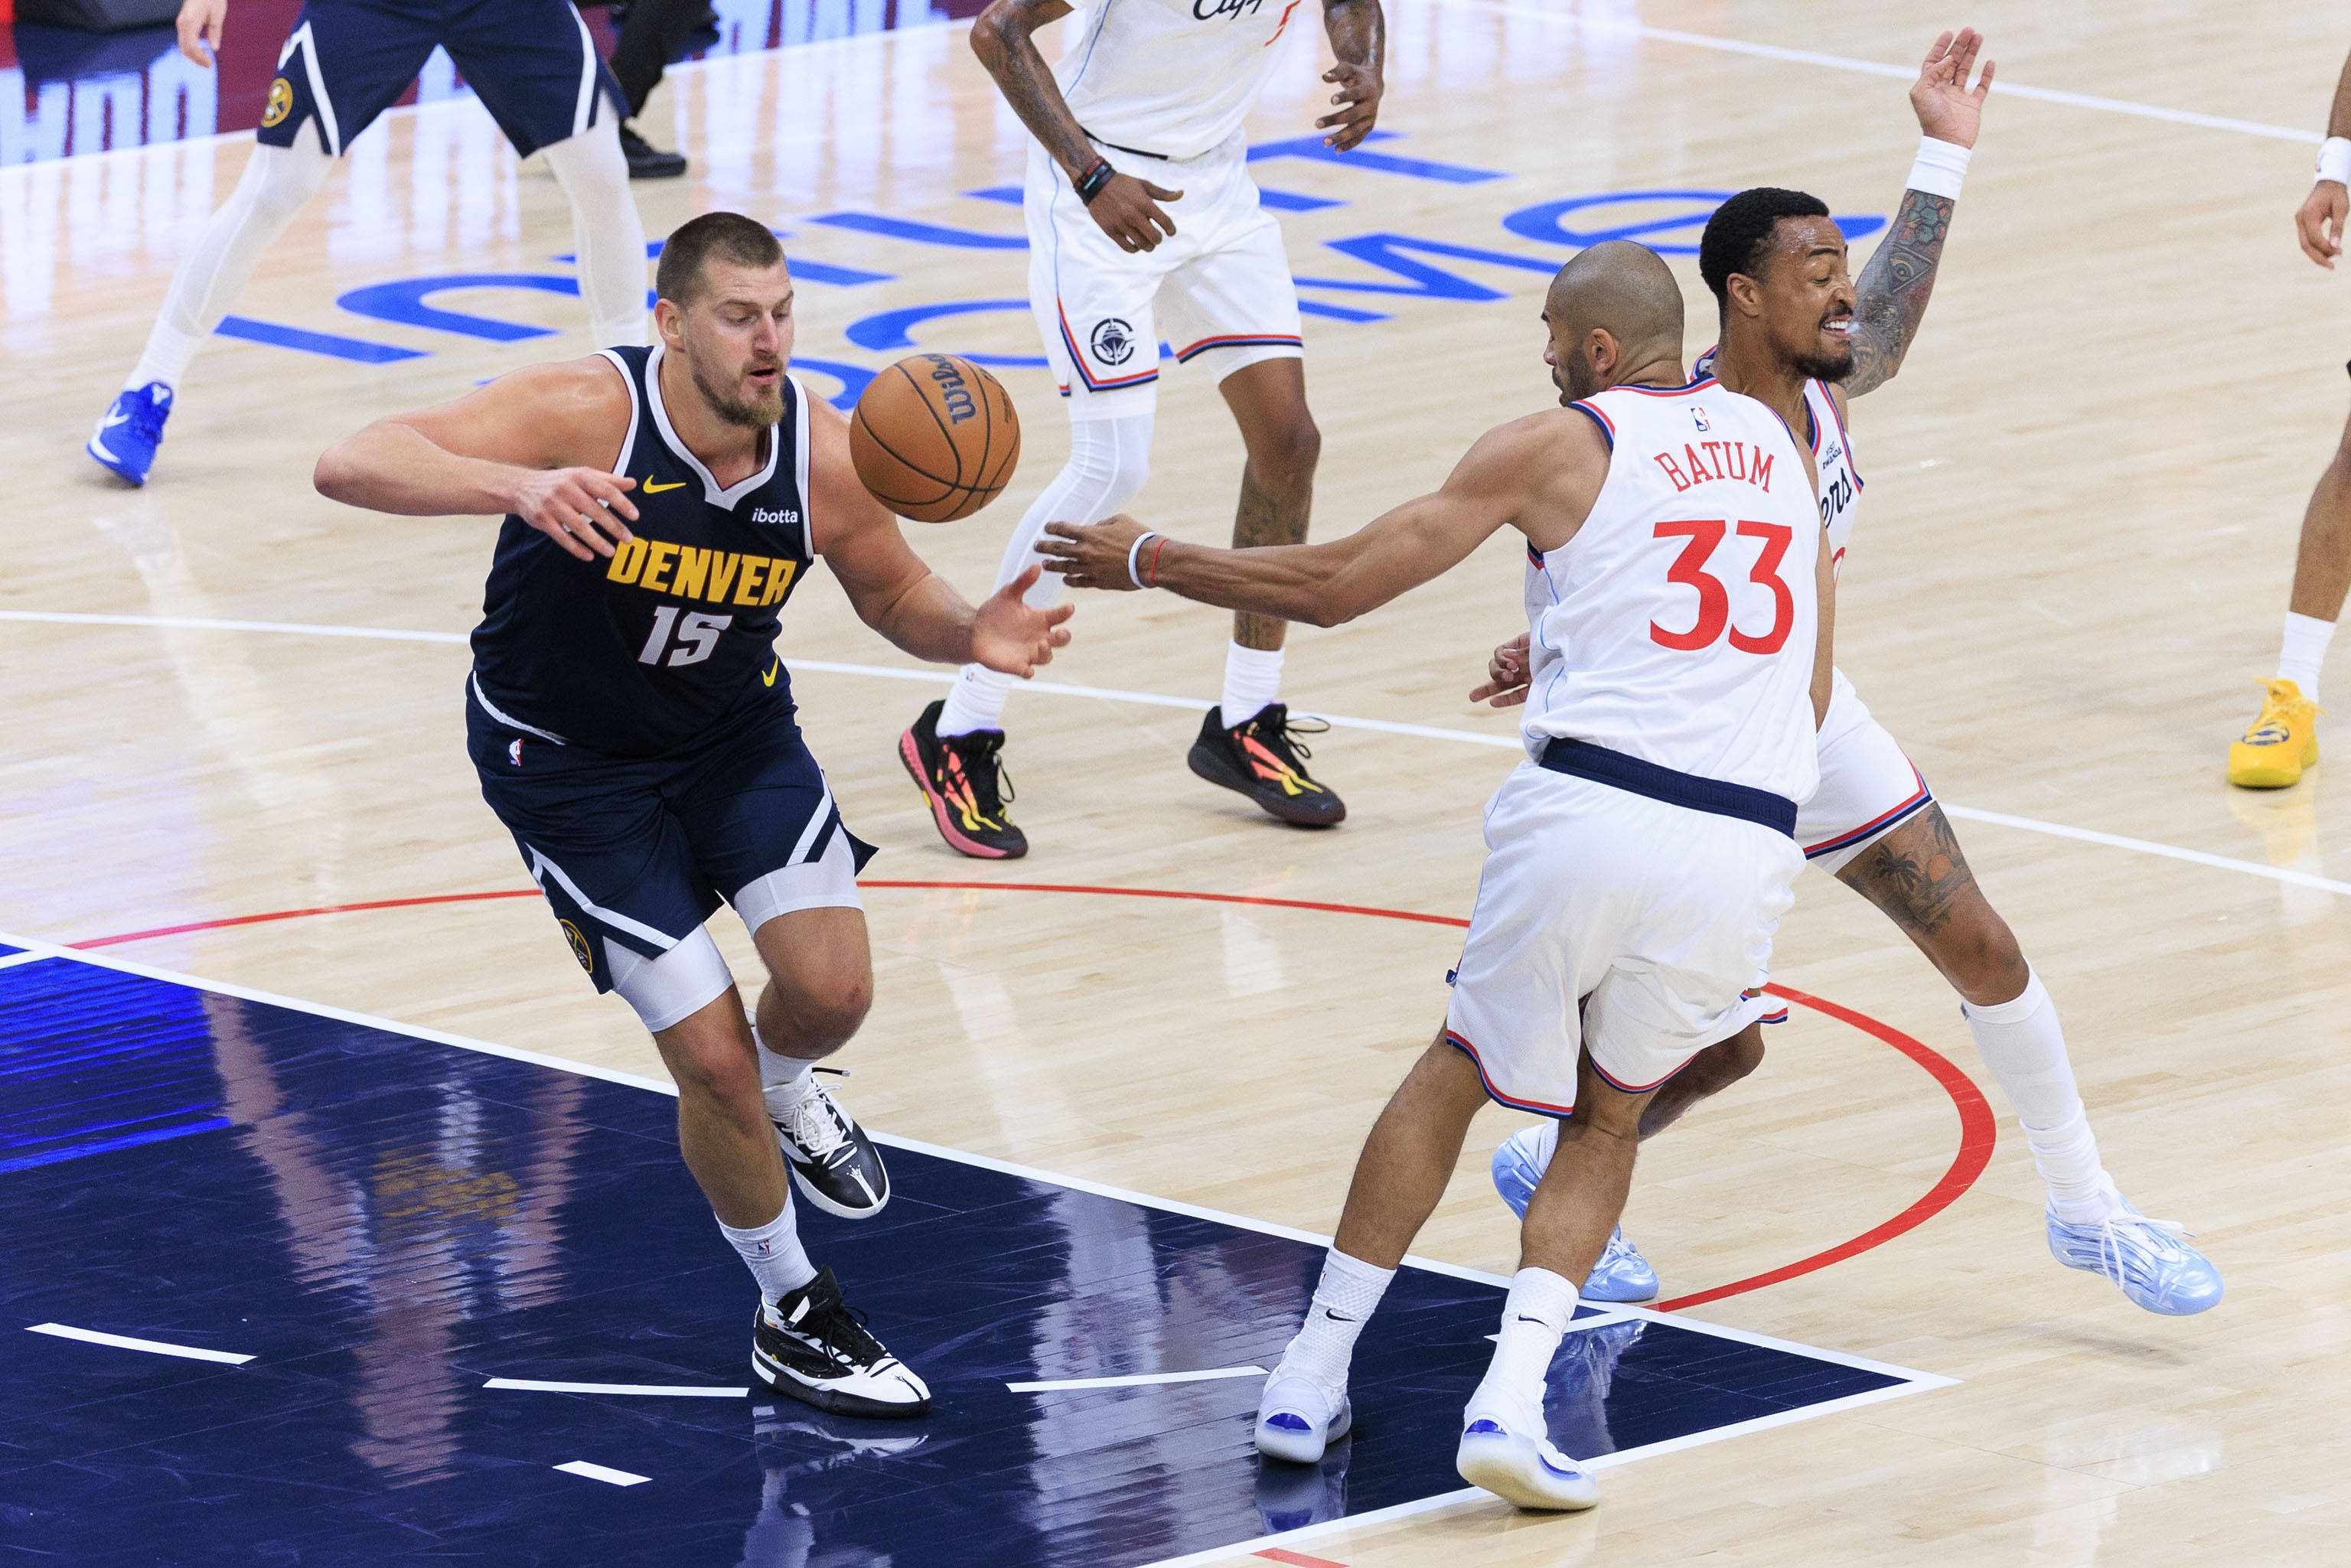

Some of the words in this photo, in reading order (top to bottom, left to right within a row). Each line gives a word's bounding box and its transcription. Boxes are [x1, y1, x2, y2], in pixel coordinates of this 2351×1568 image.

[1653, 441, 1775, 494] BATUM
[752, 507, 798, 523] ibotta
[605, 536, 797, 607] DENVER
[1650, 520, 1794, 655] 33
[637, 605, 734, 667] 15
